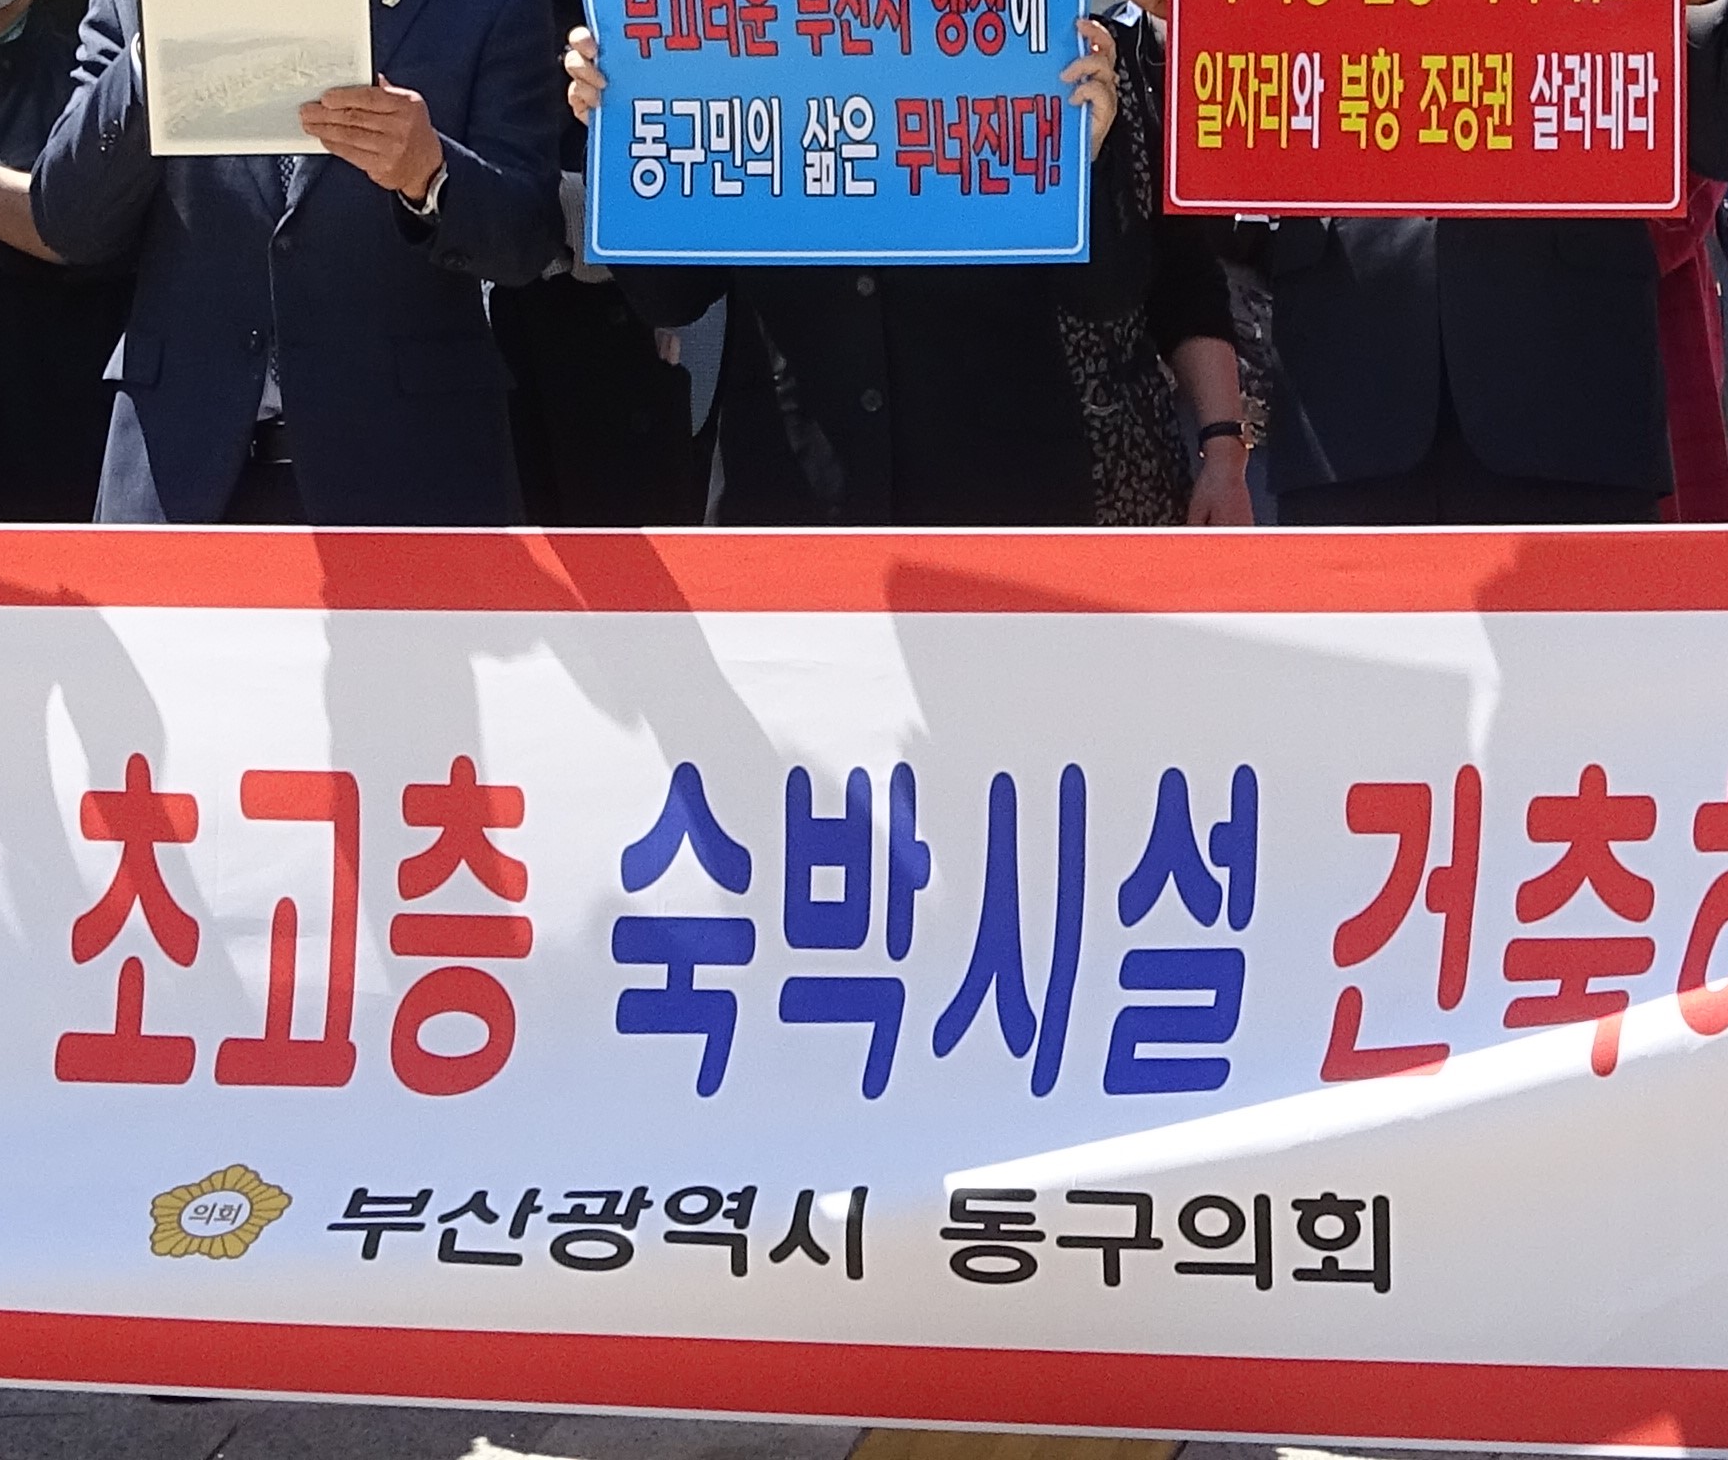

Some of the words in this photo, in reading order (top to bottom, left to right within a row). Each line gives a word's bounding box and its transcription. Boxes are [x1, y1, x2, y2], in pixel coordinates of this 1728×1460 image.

[629, 95, 782, 199] 동구민의
[802, 94, 877, 198] 삶은
[895, 94, 1062, 196] 무너진다!
[1192, 51, 1325, 150] 일자리와
[1338, 48, 1404, 152] 북항
[1417, 52, 1515, 152] 조망권
[1529, 51, 1659, 151] 살려내라
[54, 751, 535, 1097] 초고층
[611, 759, 1259, 1100] 숙박시설
[188, 1202, 243, 1226] 의회
[326, 1182, 869, 1283] 부산광역시
[939, 1187, 1394, 1294] 동구의회
